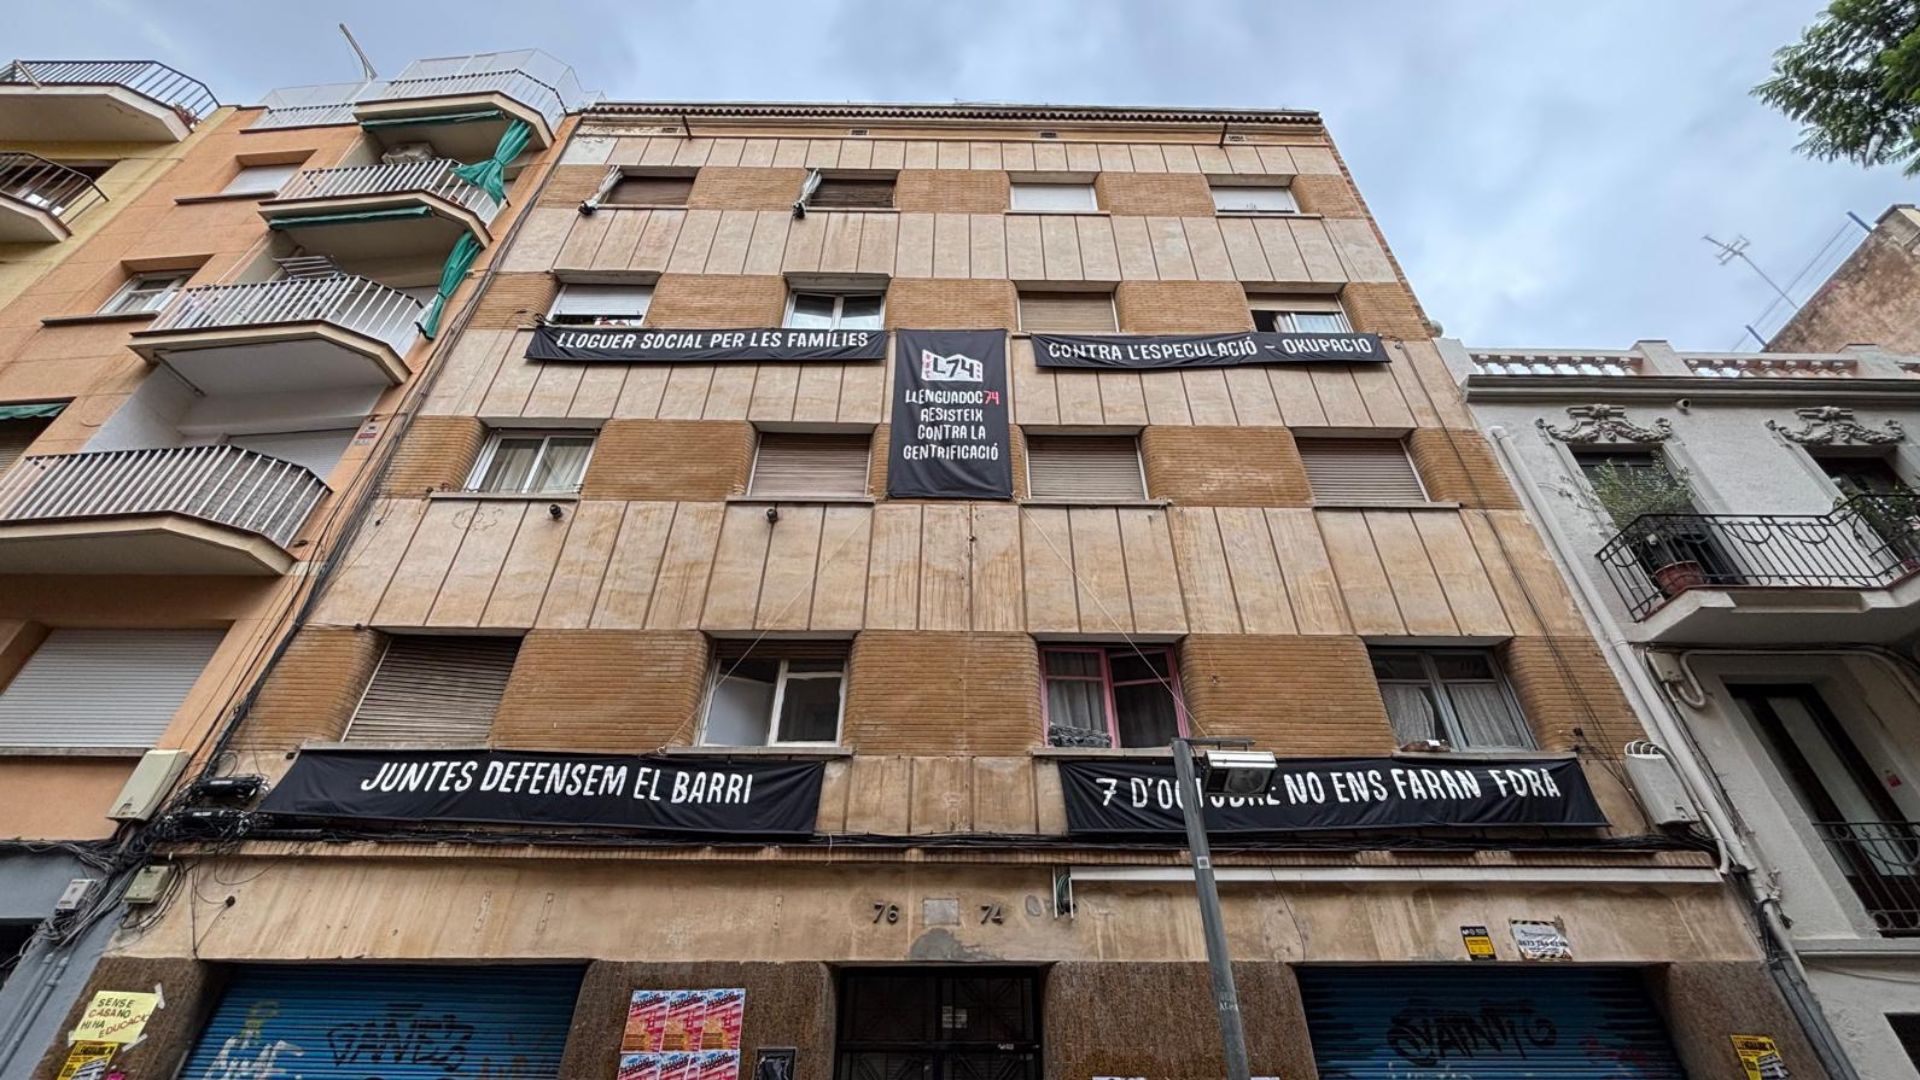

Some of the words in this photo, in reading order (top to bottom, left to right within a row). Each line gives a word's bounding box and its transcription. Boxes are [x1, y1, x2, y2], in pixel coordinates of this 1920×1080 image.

[557, 332, 637, 349] LLOGUER
[641, 333, 703, 349] SOCIAL
[709, 332, 746, 349] PER
[750, 331, 783, 348] LES
[1048, 342, 1122, 361] CONTRA
[932, 357, 975, 379] L74
[920, 407, 983, 422] RESISTEIX
[917, 424, 968, 441] CONTRA
[970, 425, 986, 440] LA
[361, 761, 479, 792] JUNTES
[479, 761, 628, 796] DEFENSEM
[633, 767, 661, 801] EL
[671, 771, 753, 804] BARRI
[1096, 778, 1118, 807] 7
[1283, 772, 1326, 805] NO
[1329, 769, 1388, 803] ENS
[1390, 768, 1482, 800] FARAN
[1487, 768, 1561, 798] FORA
[979, 903, 1004, 926] 74
[97, 998, 136, 1009] SENSE
[88, 1009, 117, 1019] CASA
[116, 1009, 132, 1019] NO
[80, 1019, 91, 1030] HI
[92, 1020, 106, 1030] HA
